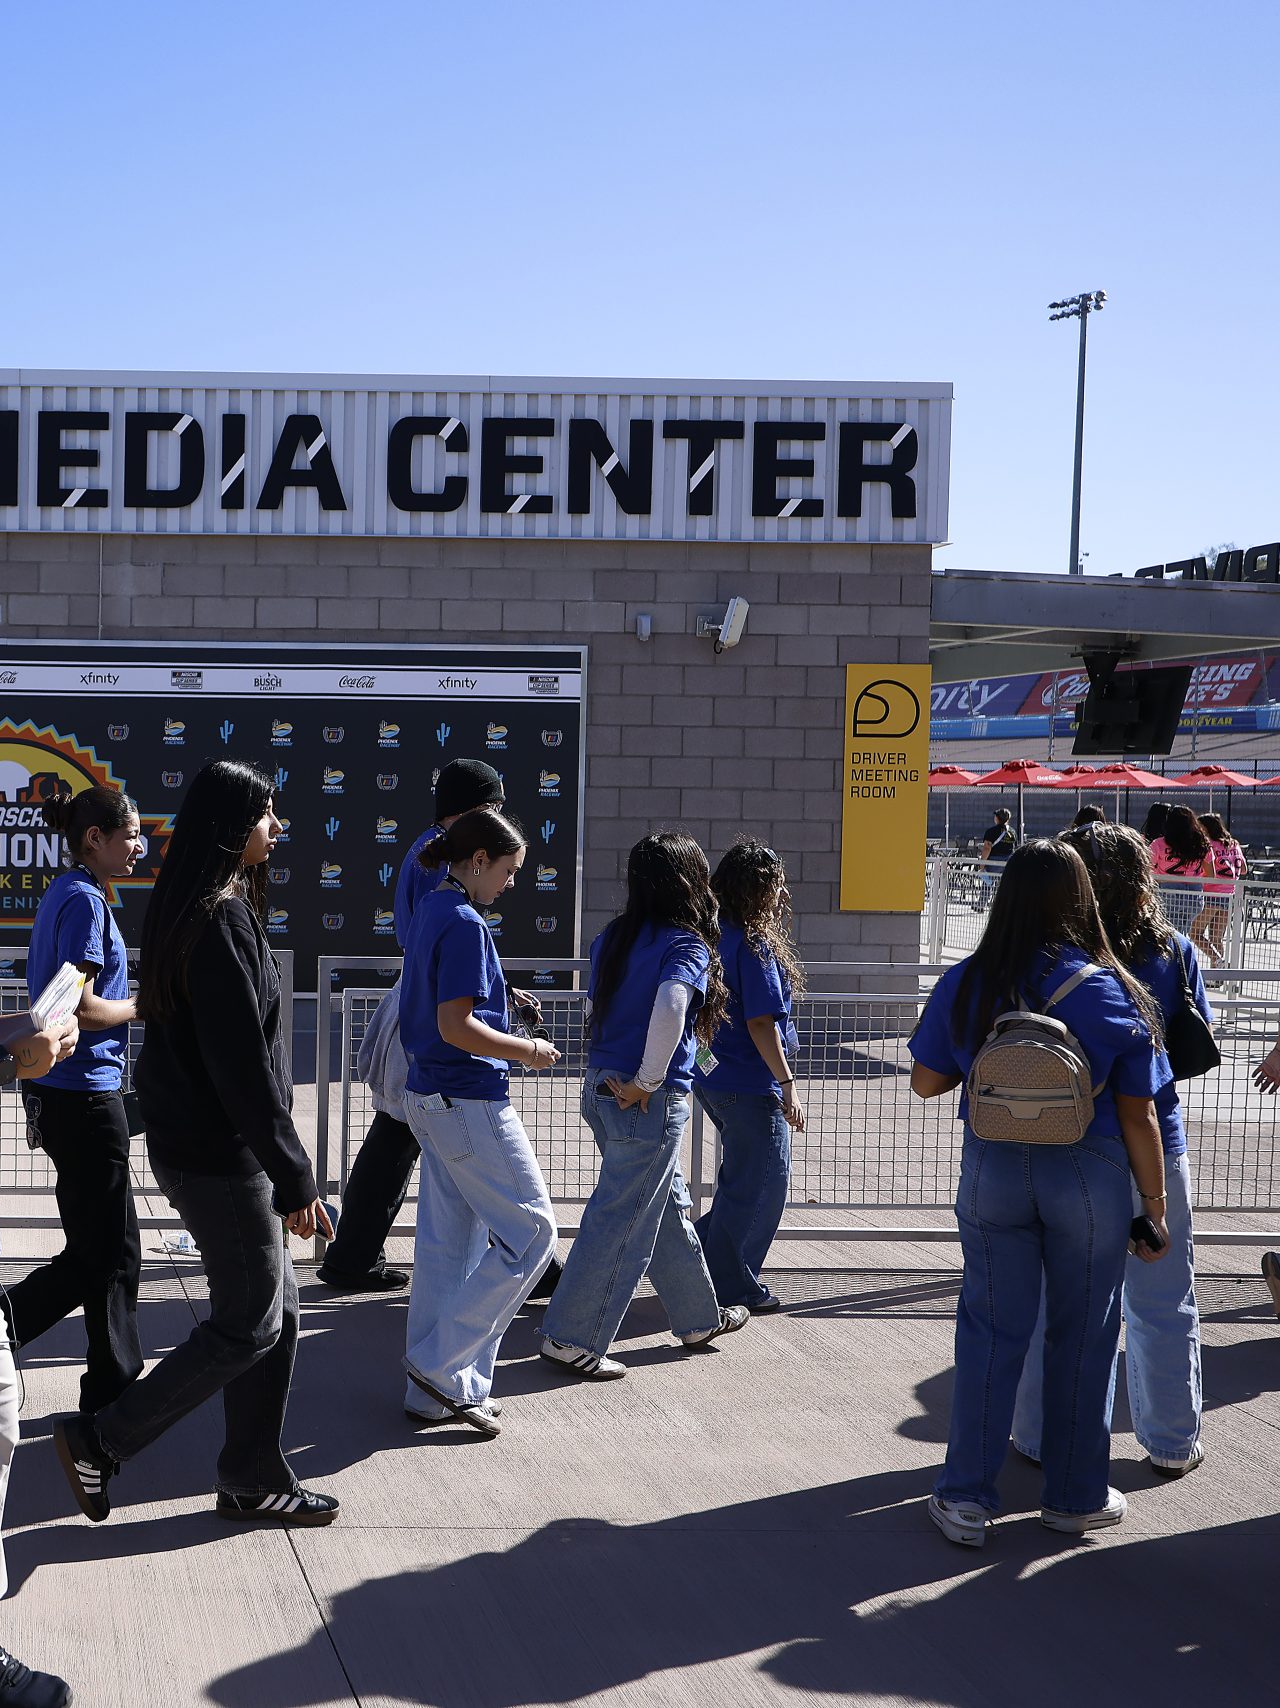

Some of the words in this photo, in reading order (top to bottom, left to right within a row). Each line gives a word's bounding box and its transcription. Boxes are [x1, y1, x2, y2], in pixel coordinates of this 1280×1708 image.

[388, 415, 919, 519] CENTER
[80, 671, 120, 685] xfinity
[254, 678, 282, 687] BUSCH
[438, 676, 478, 690] xfinity
[851, 752, 907, 765] DRIVER
[851, 769, 919, 782] MEETING
[850, 785, 896, 798] ROOM
